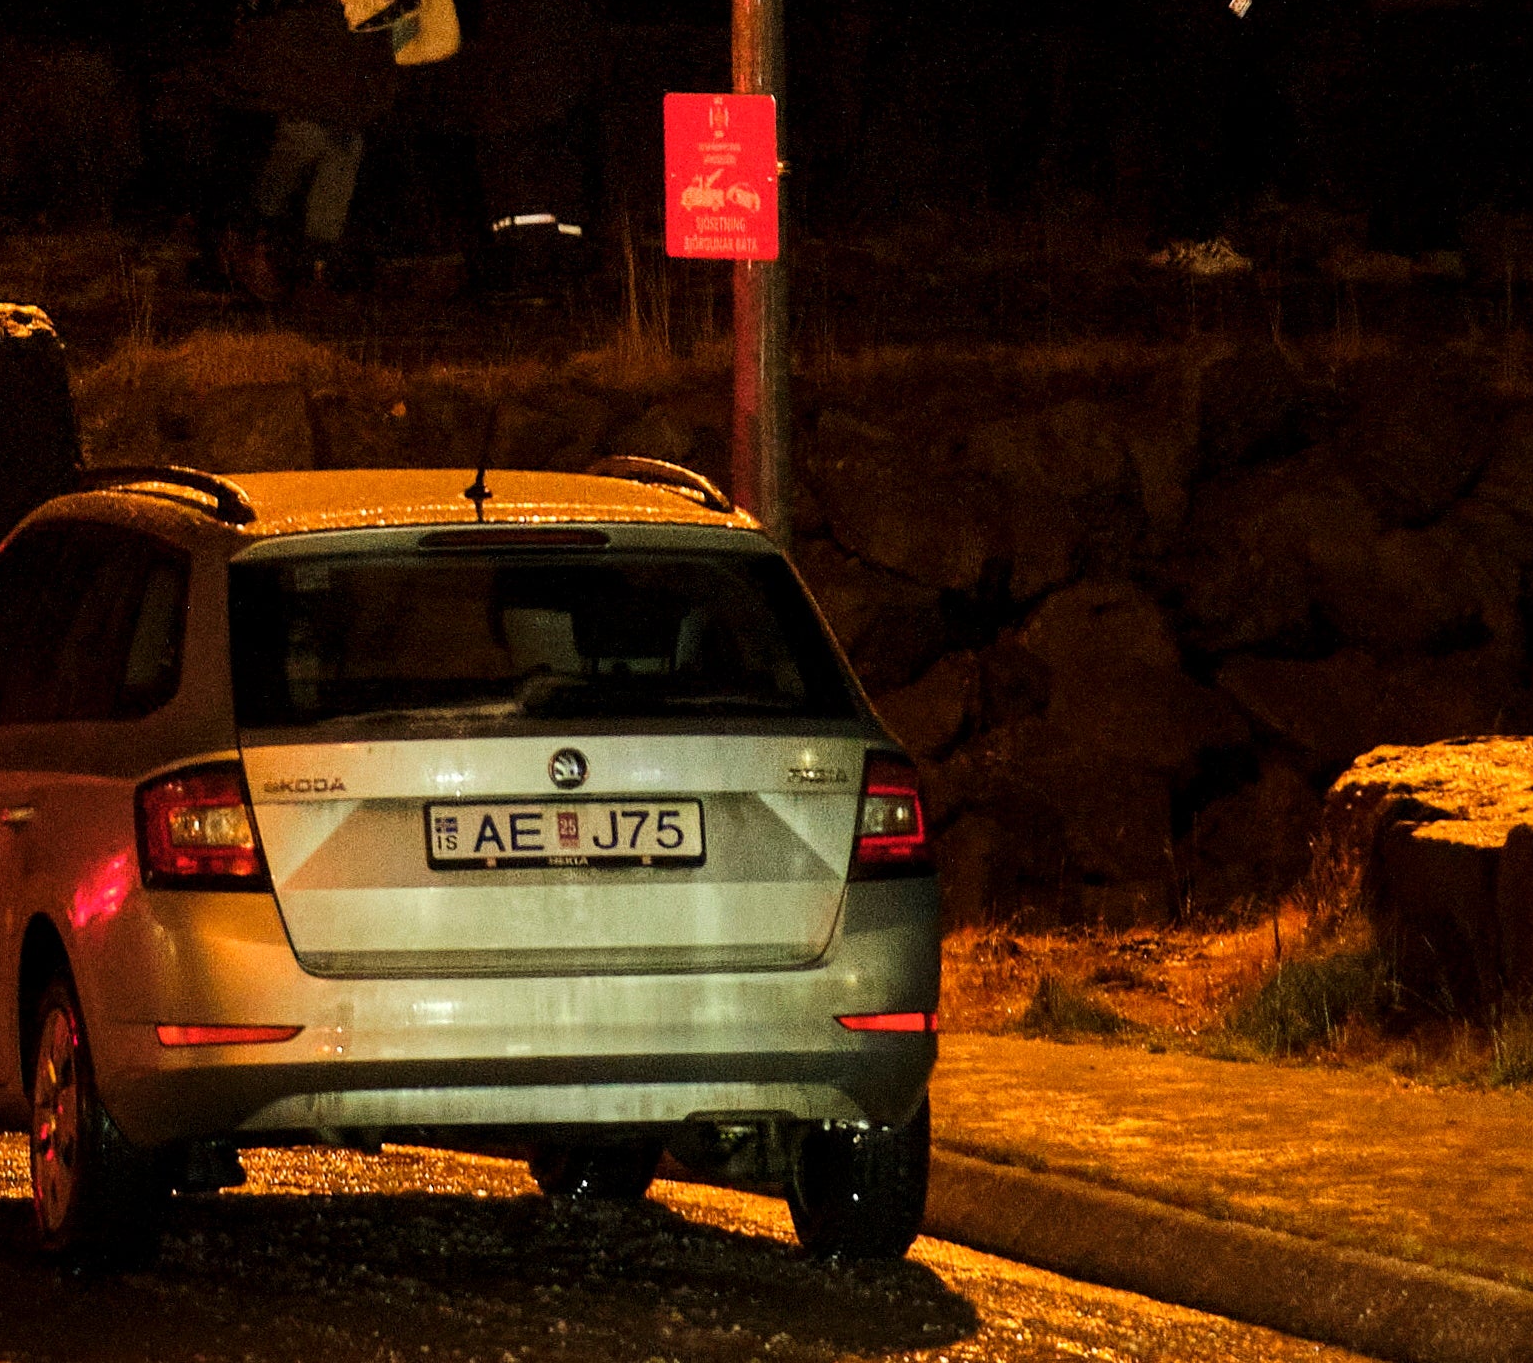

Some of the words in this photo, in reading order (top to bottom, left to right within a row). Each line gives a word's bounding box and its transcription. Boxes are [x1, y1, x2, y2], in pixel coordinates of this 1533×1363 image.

[434, 835, 458, 852] IS
[473, 812, 545, 853] AE
[592, 810, 685, 850] J75
